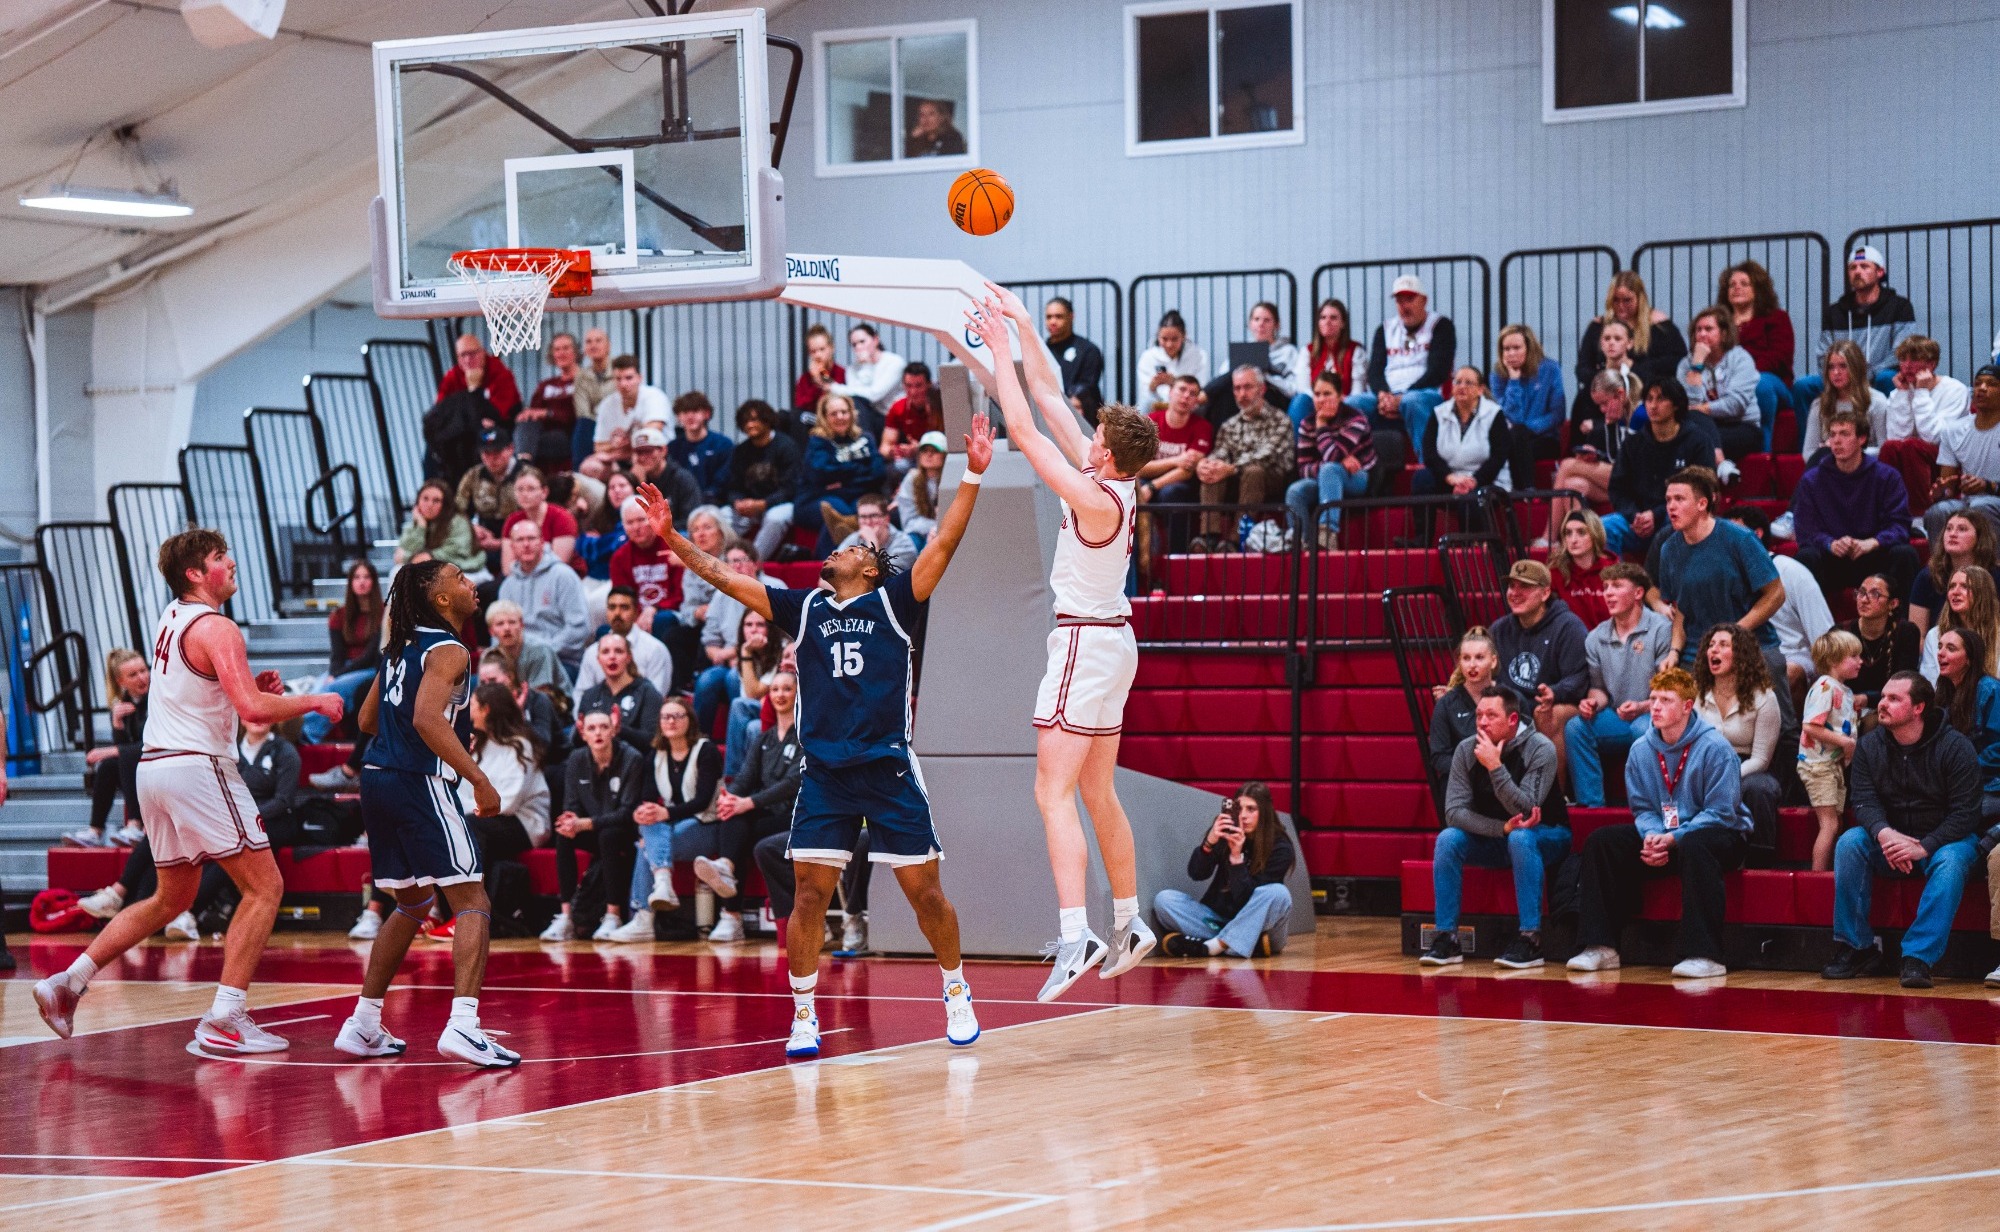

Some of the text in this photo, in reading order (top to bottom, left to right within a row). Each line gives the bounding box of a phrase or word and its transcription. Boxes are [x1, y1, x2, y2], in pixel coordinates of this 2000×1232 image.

[786, 257, 840, 282] PALDING
[401, 289, 436, 300] SPALDING
[818, 618, 875, 638] WESLEYAN
[155, 626, 174, 675] 44
[830, 641, 865, 678] 15
